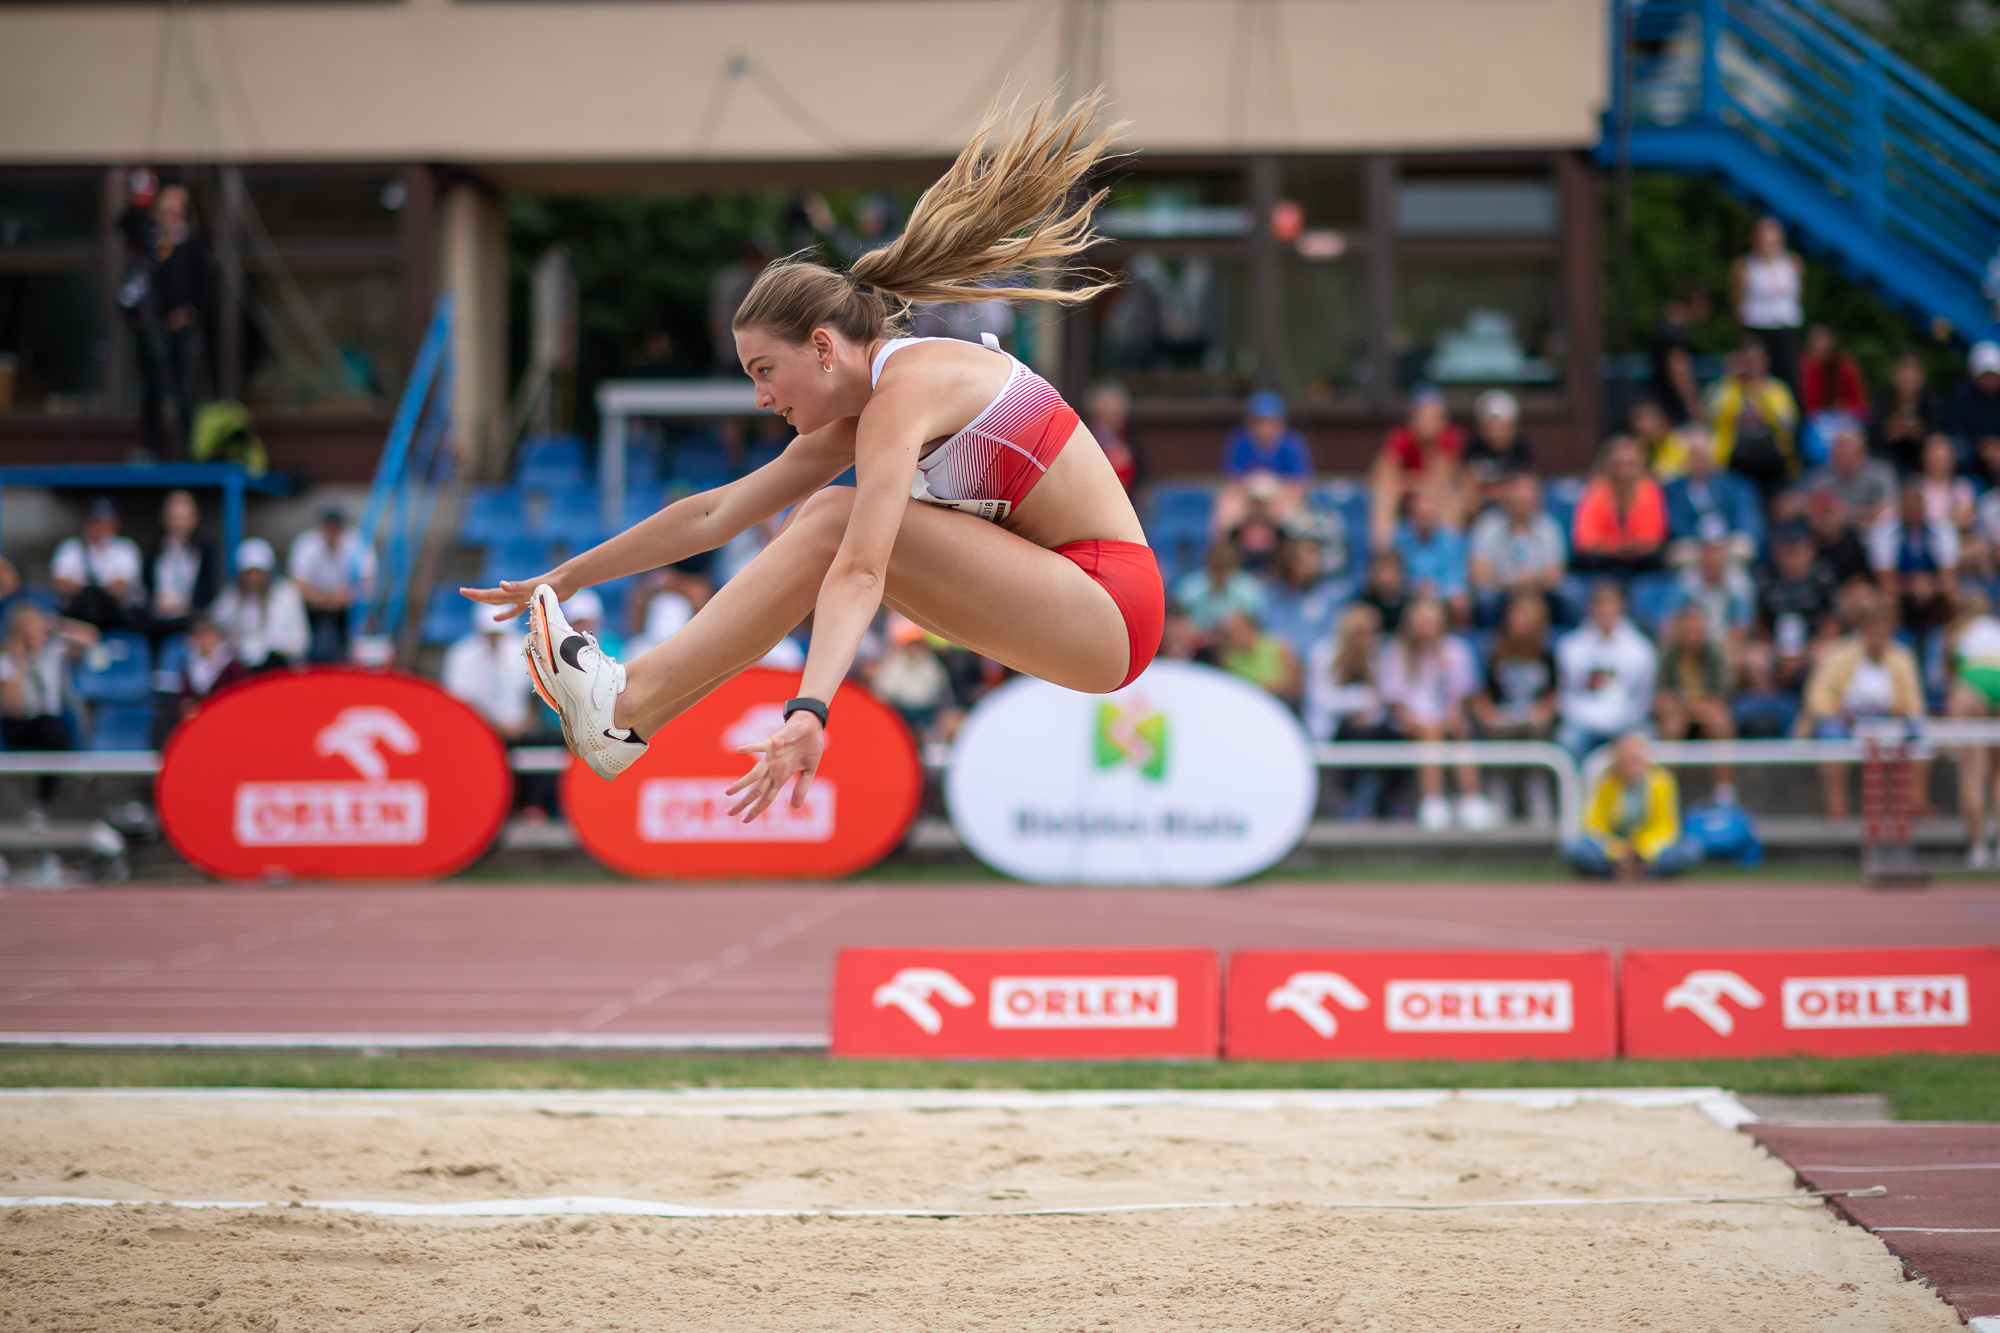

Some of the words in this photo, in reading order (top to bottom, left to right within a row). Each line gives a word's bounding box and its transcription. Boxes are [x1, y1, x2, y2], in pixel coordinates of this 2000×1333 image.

[252, 797, 407, 831] ORLEN
[1007, 988, 1159, 1017] ORLEN
[1402, 992, 1555, 1021] ORLEN
[1798, 988, 1954, 1017] ORLEN
